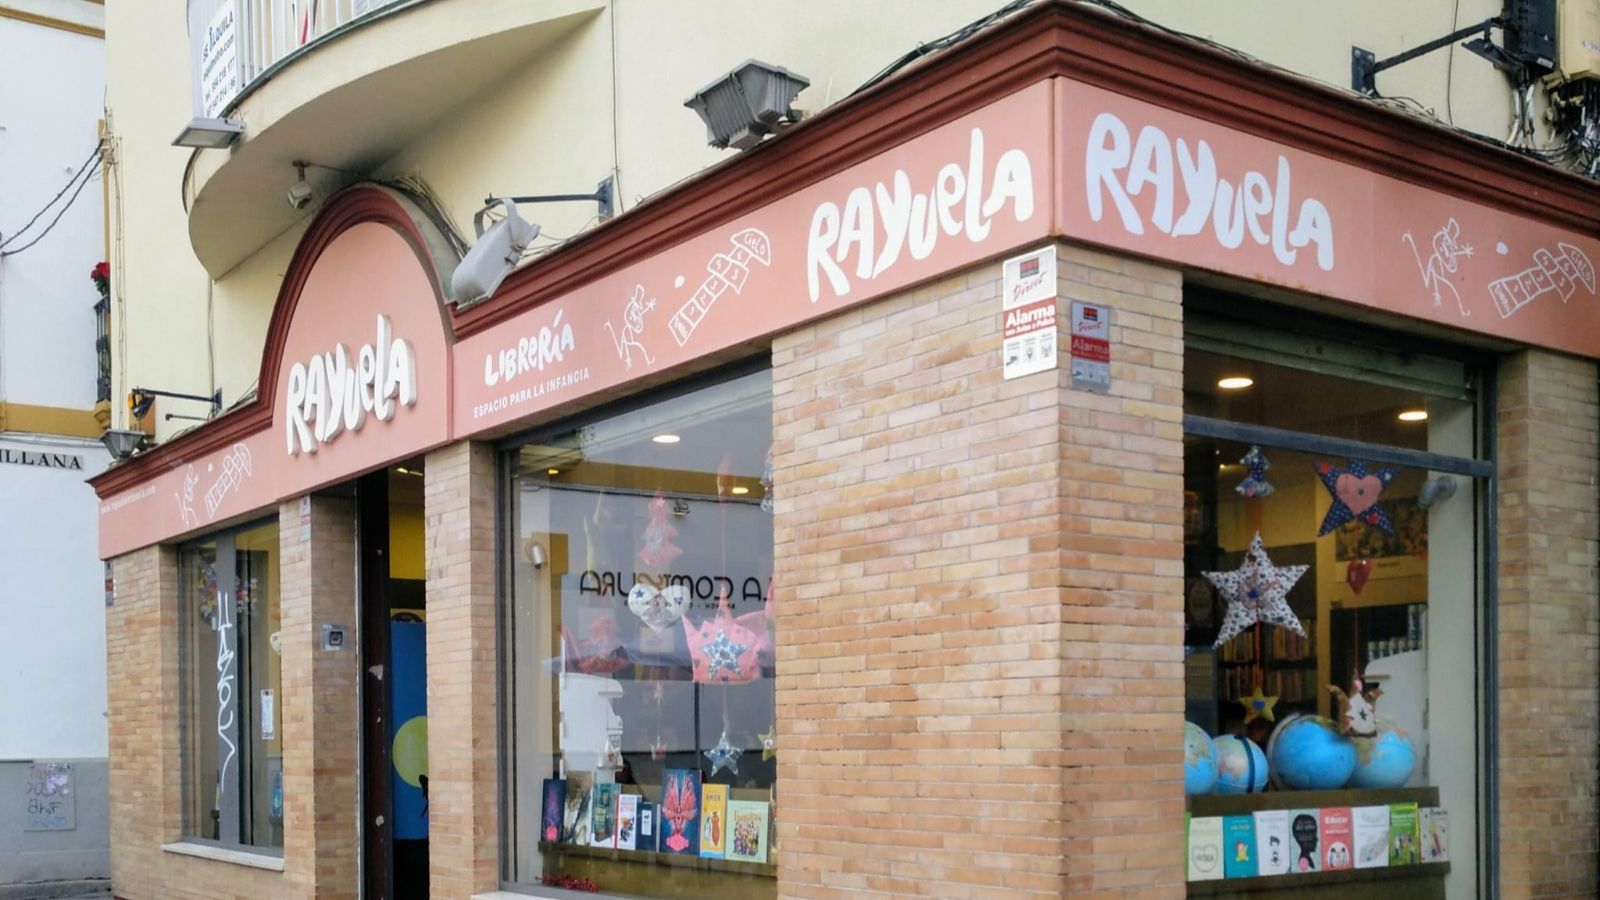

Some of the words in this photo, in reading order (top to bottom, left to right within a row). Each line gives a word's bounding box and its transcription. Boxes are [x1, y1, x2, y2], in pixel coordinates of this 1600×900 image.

[1006, 304, 1055, 329] Alarma
[473, 396, 508, 418] ESPACIO
[509, 388, 532, 406] PARA
[533, 384, 545, 398] LA
[546, 367, 590, 393] INFANCIA
